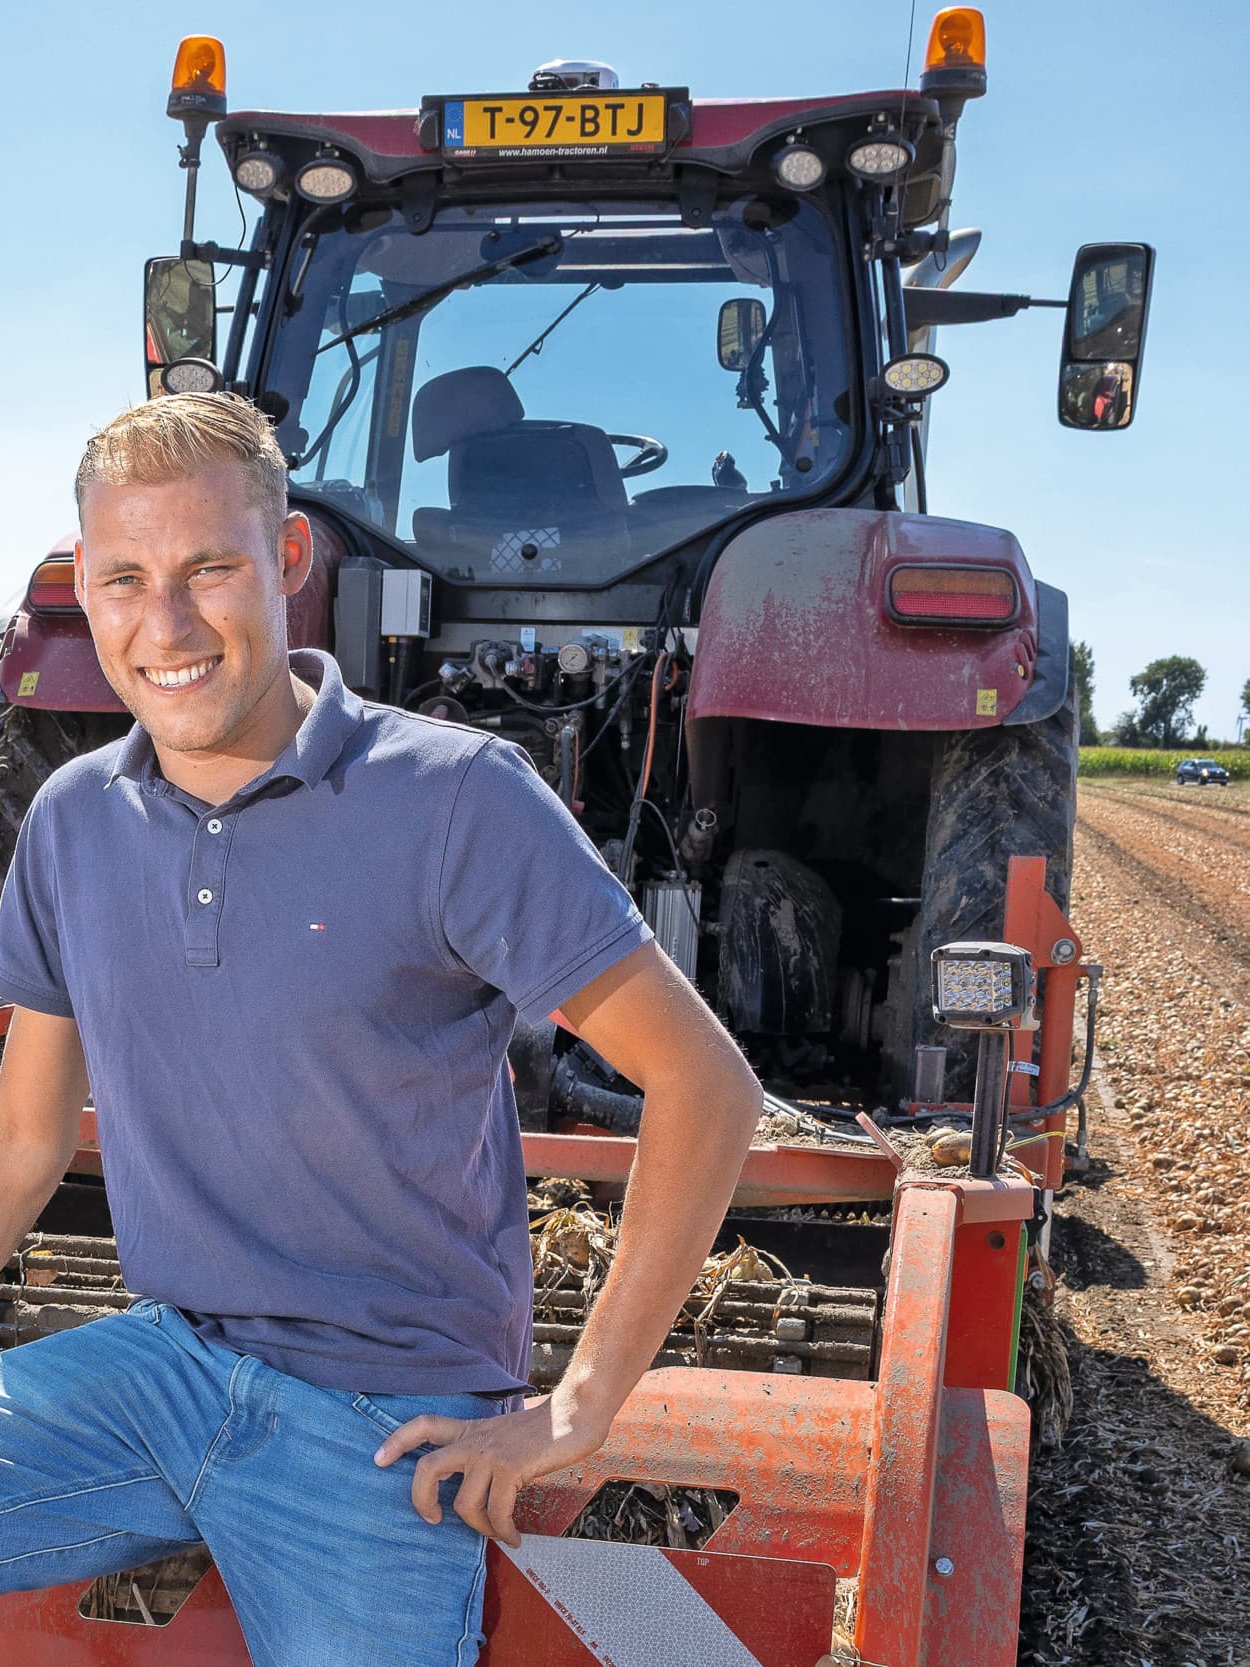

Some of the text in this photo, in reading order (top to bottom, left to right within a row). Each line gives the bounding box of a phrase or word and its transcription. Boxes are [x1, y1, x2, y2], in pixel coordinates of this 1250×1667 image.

[482, 102, 644, 139] T-97-BTJ
[447, 128, 461, 139] NL
[498, 145, 608, 157] www.hamoen-tractoren.nl
[696, 1556, 710, 1567] TOP
